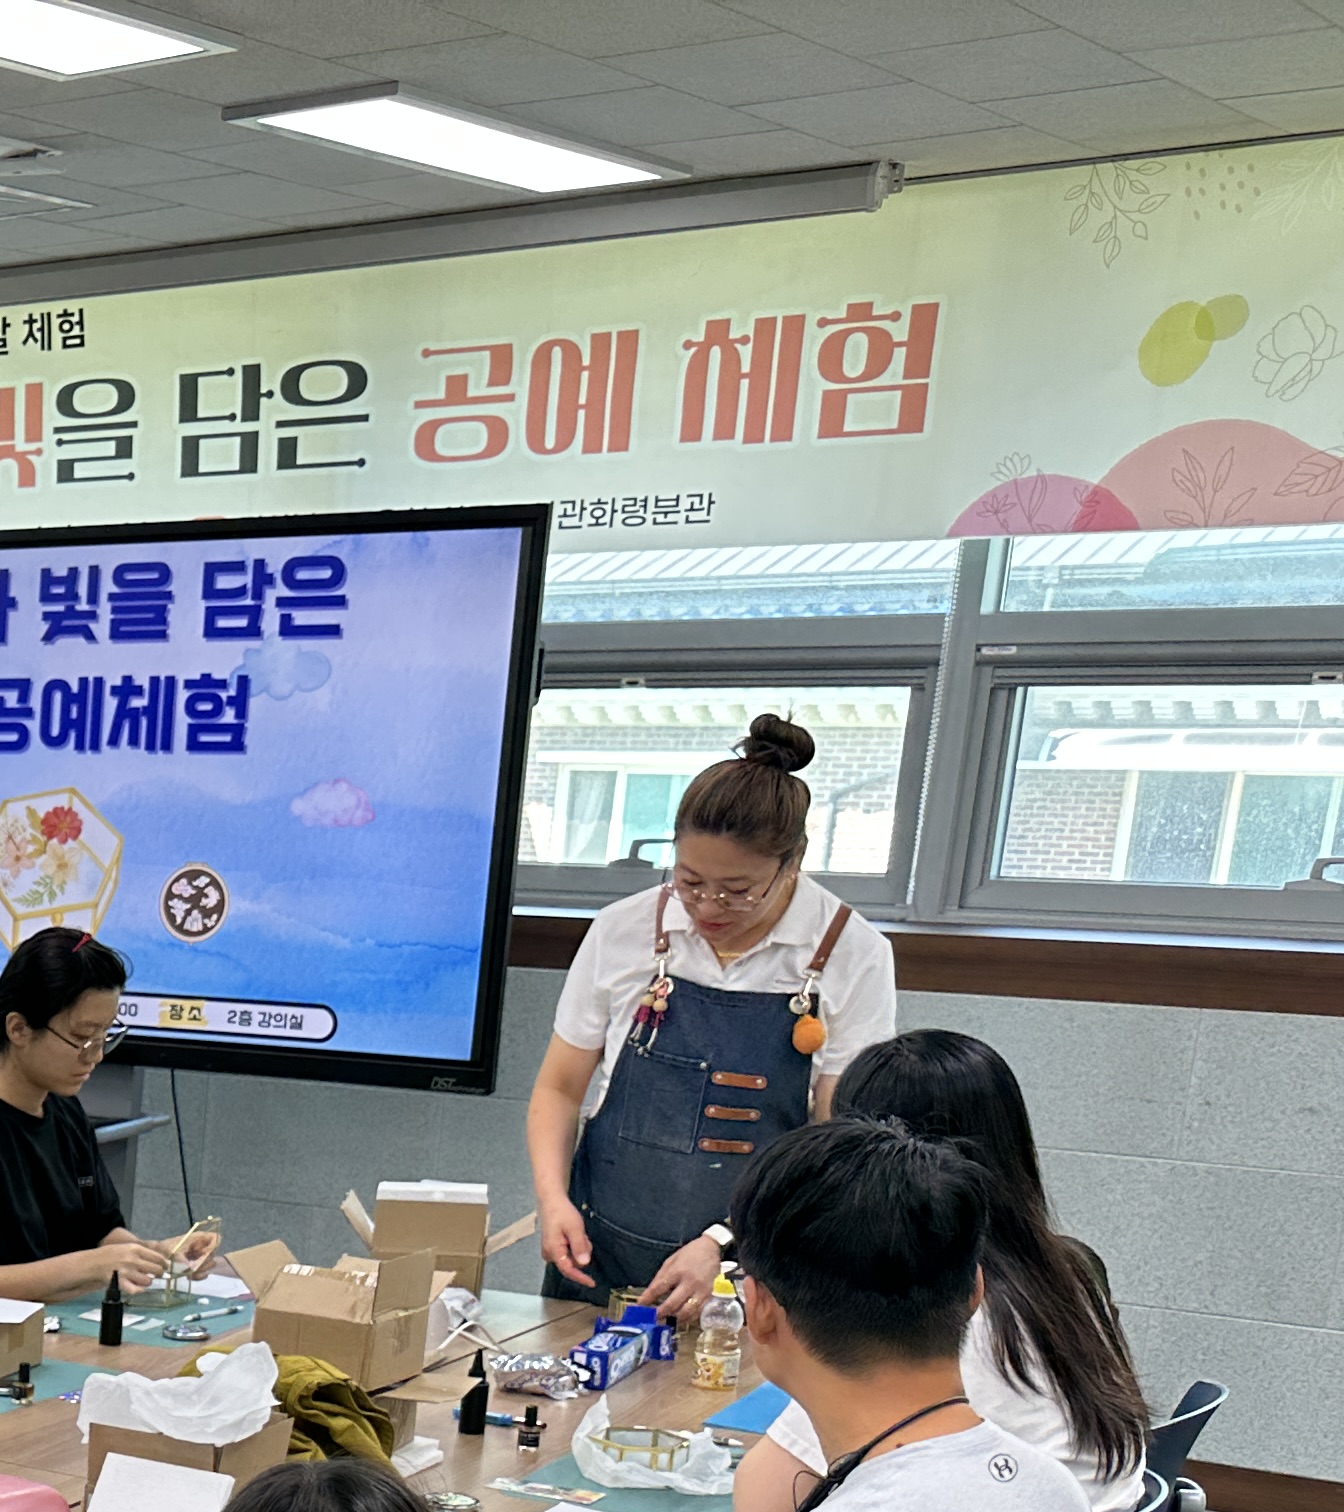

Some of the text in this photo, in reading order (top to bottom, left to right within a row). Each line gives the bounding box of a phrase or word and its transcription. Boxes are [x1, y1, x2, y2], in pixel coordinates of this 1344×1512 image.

[21, 307, 87, 352] 체험
[177, 358, 371, 479] 담은
[412, 328, 641, 464] 공예
[678, 300, 941, 446] 체험
[38, 560, 175, 646] 빛을
[200, 554, 349, 642] 담은
[226, 1010, 253, 1027] 2층
[257, 1011, 304, 1031] 강의실
